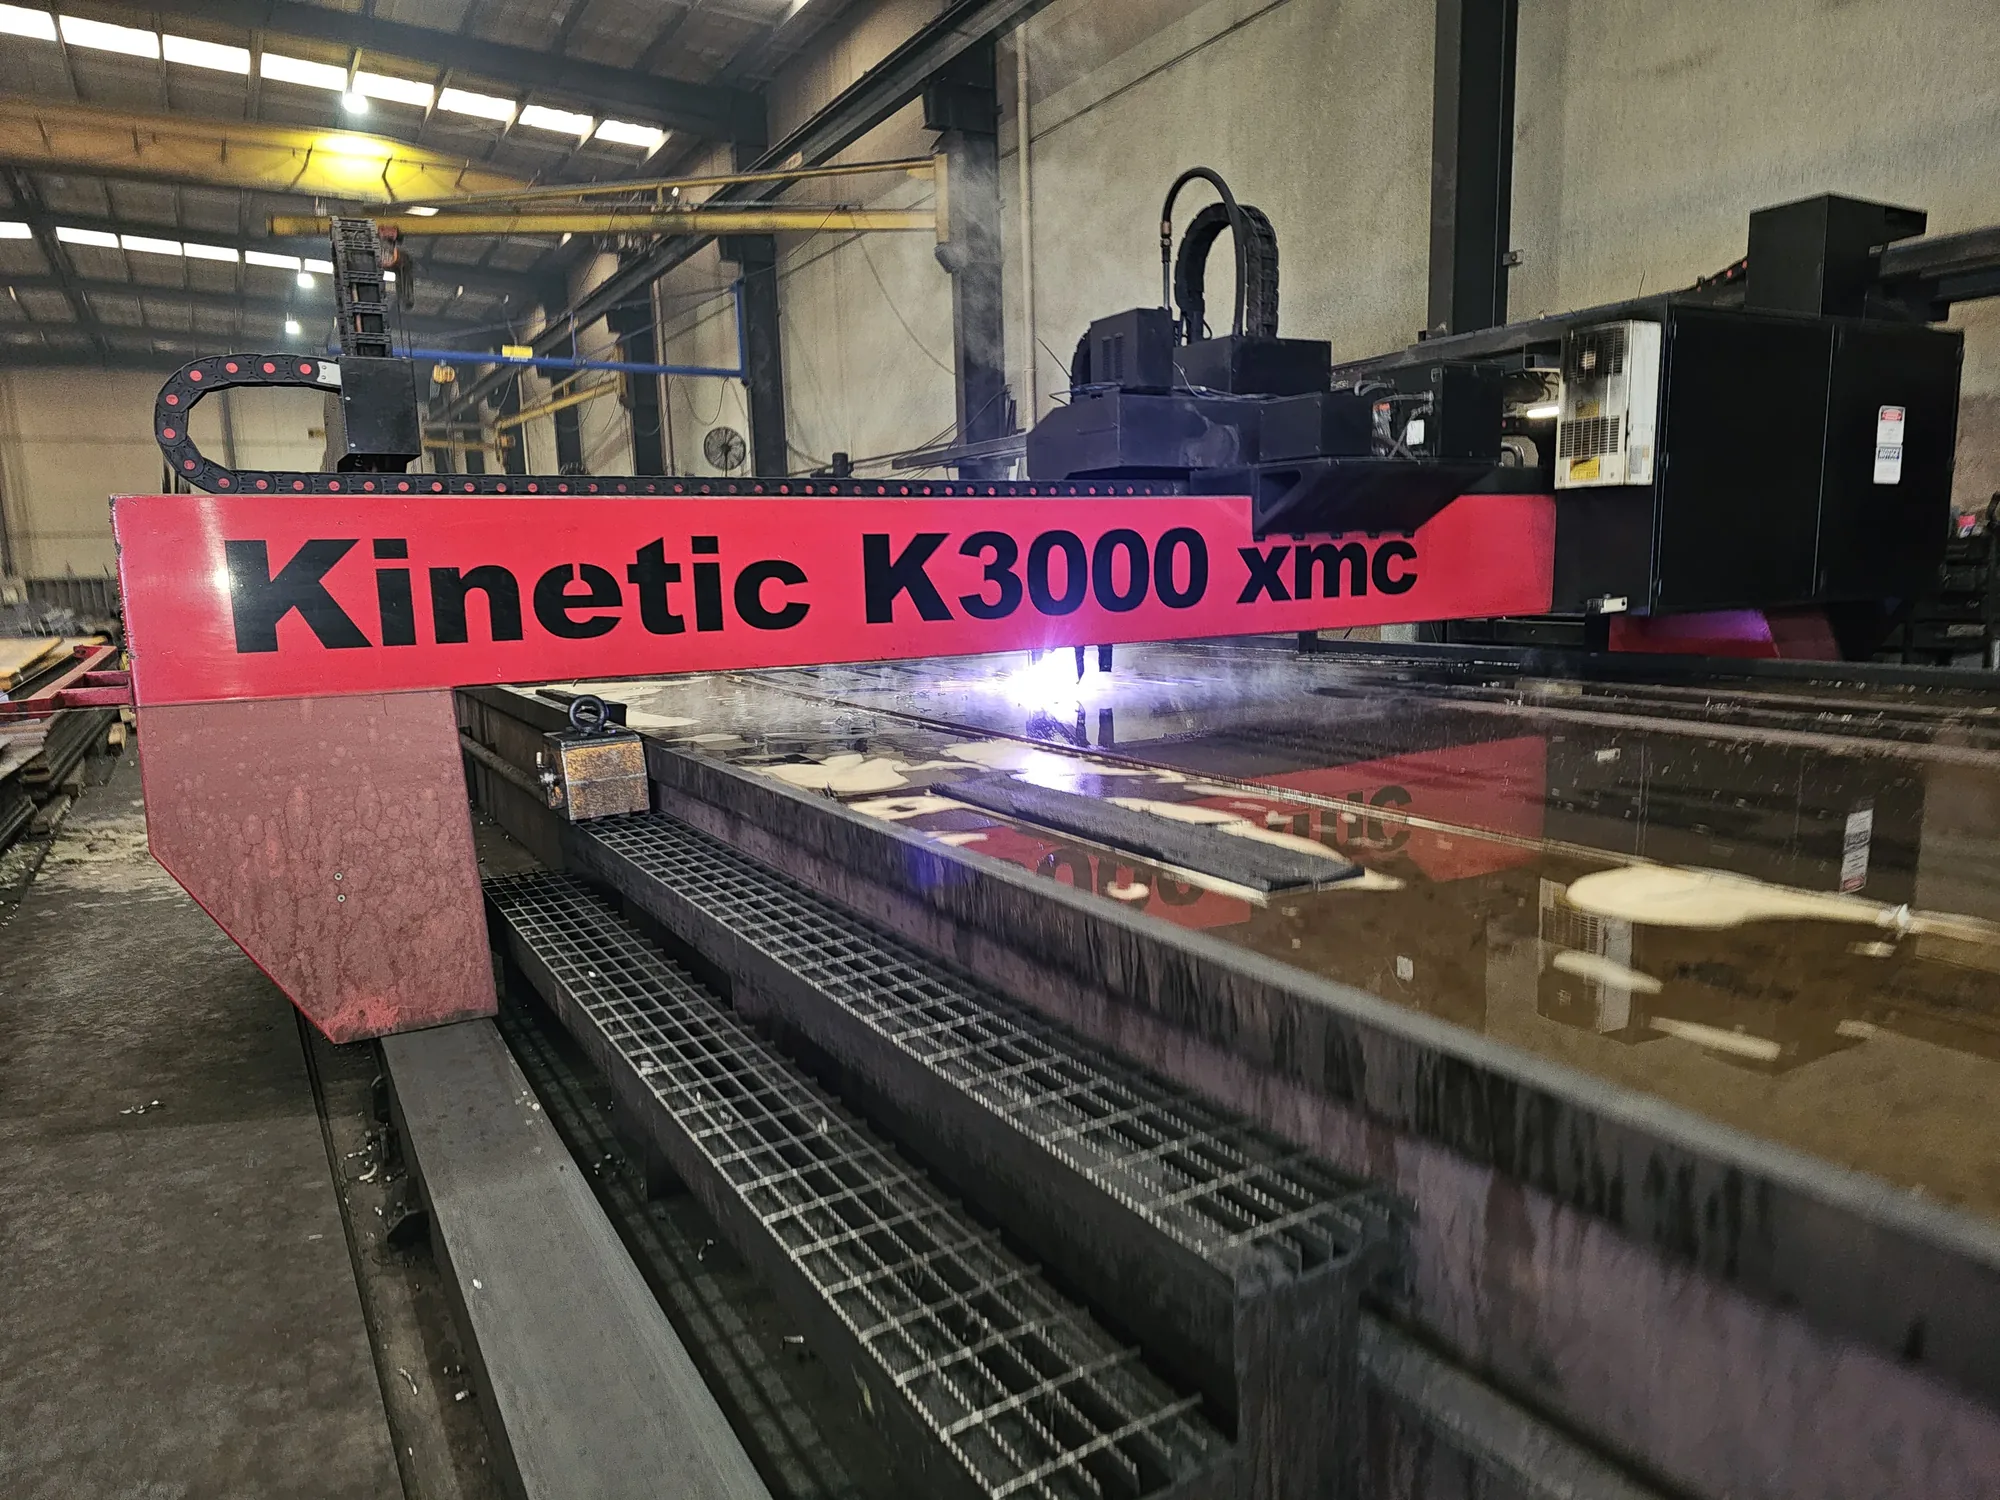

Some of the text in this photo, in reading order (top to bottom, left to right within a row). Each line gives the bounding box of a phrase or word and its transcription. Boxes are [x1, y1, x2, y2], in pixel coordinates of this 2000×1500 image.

[225, 527, 1418, 653] Kinetic K3000 xmc
